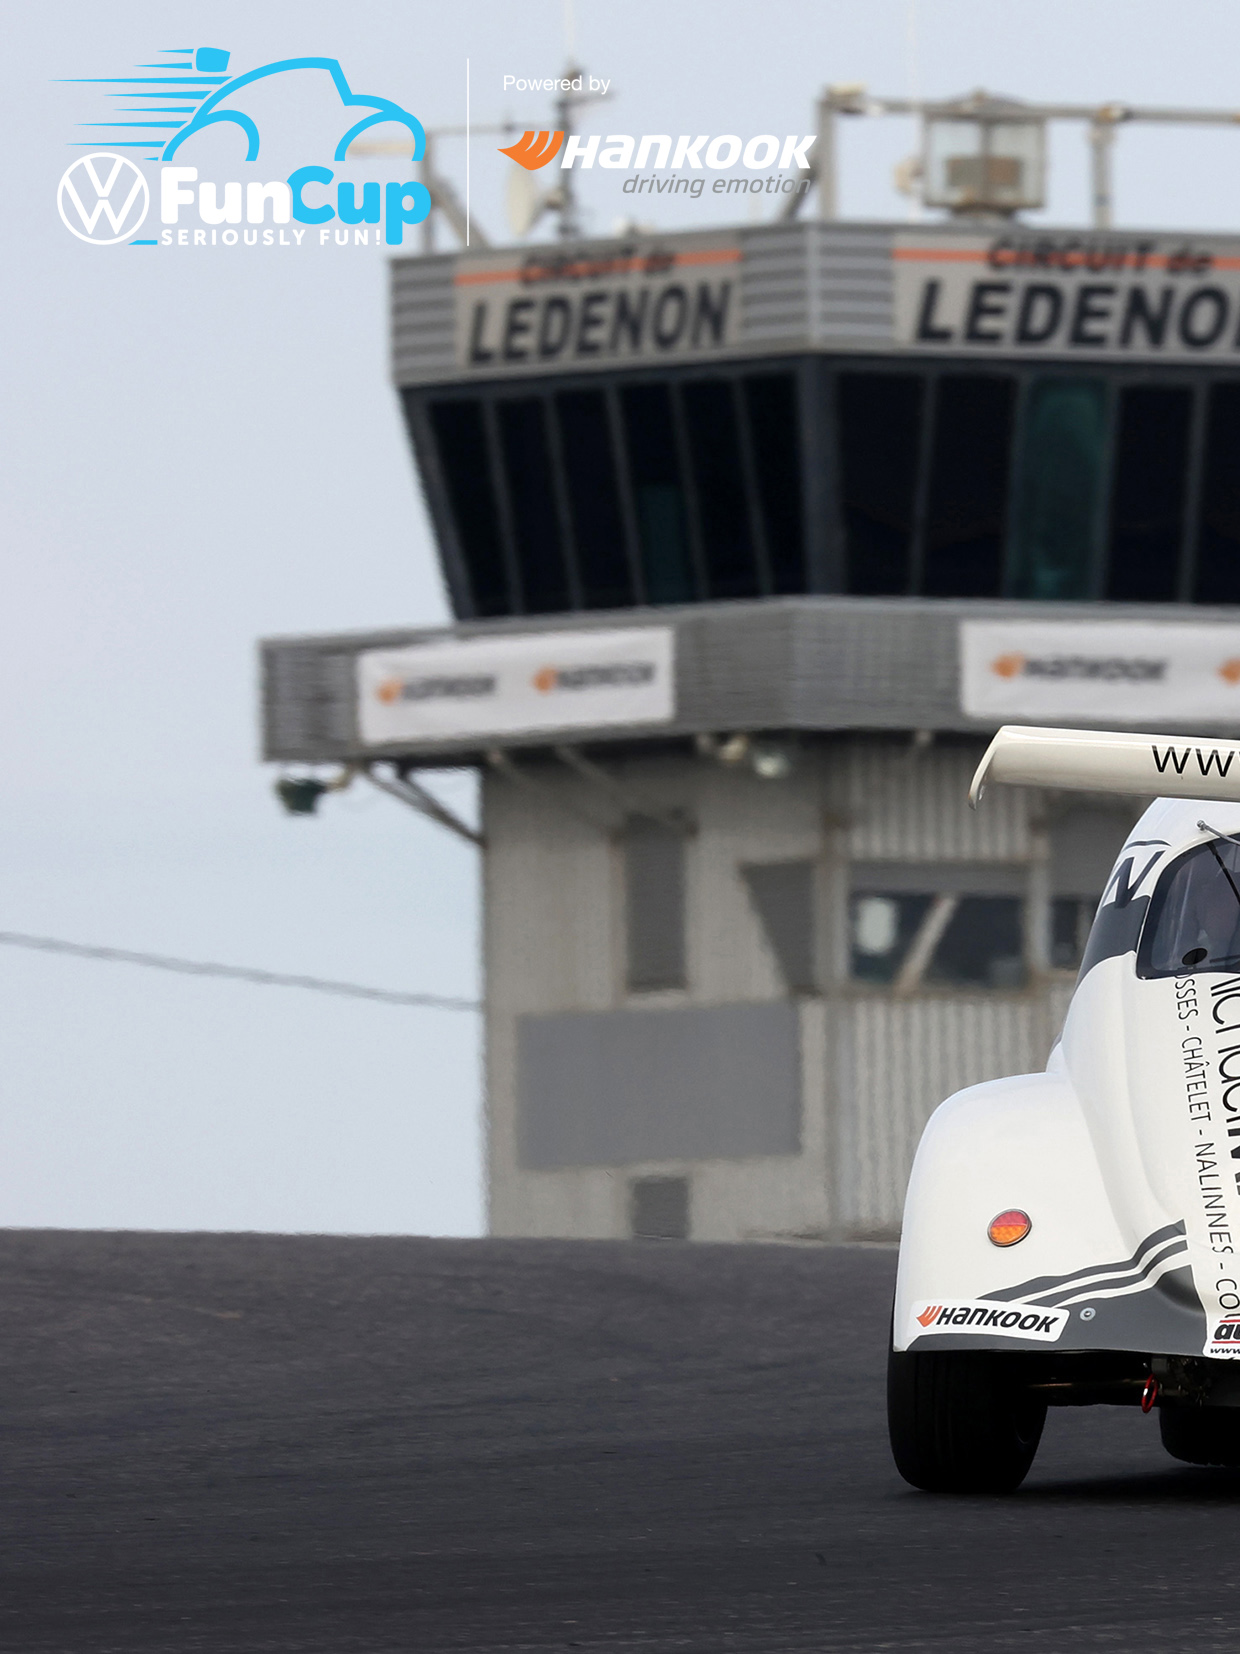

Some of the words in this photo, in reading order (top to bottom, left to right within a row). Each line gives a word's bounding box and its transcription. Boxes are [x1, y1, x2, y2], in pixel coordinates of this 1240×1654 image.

[986, 236, 1155, 273] CIRCUIT
[469, 280, 732, 363] LEDENON
[1174, 973, 1199, 1021] SSES
[1181, 1035, 1212, 1122] CHÂTELET
[1194, 1142, 1234, 1254] NALINNES
